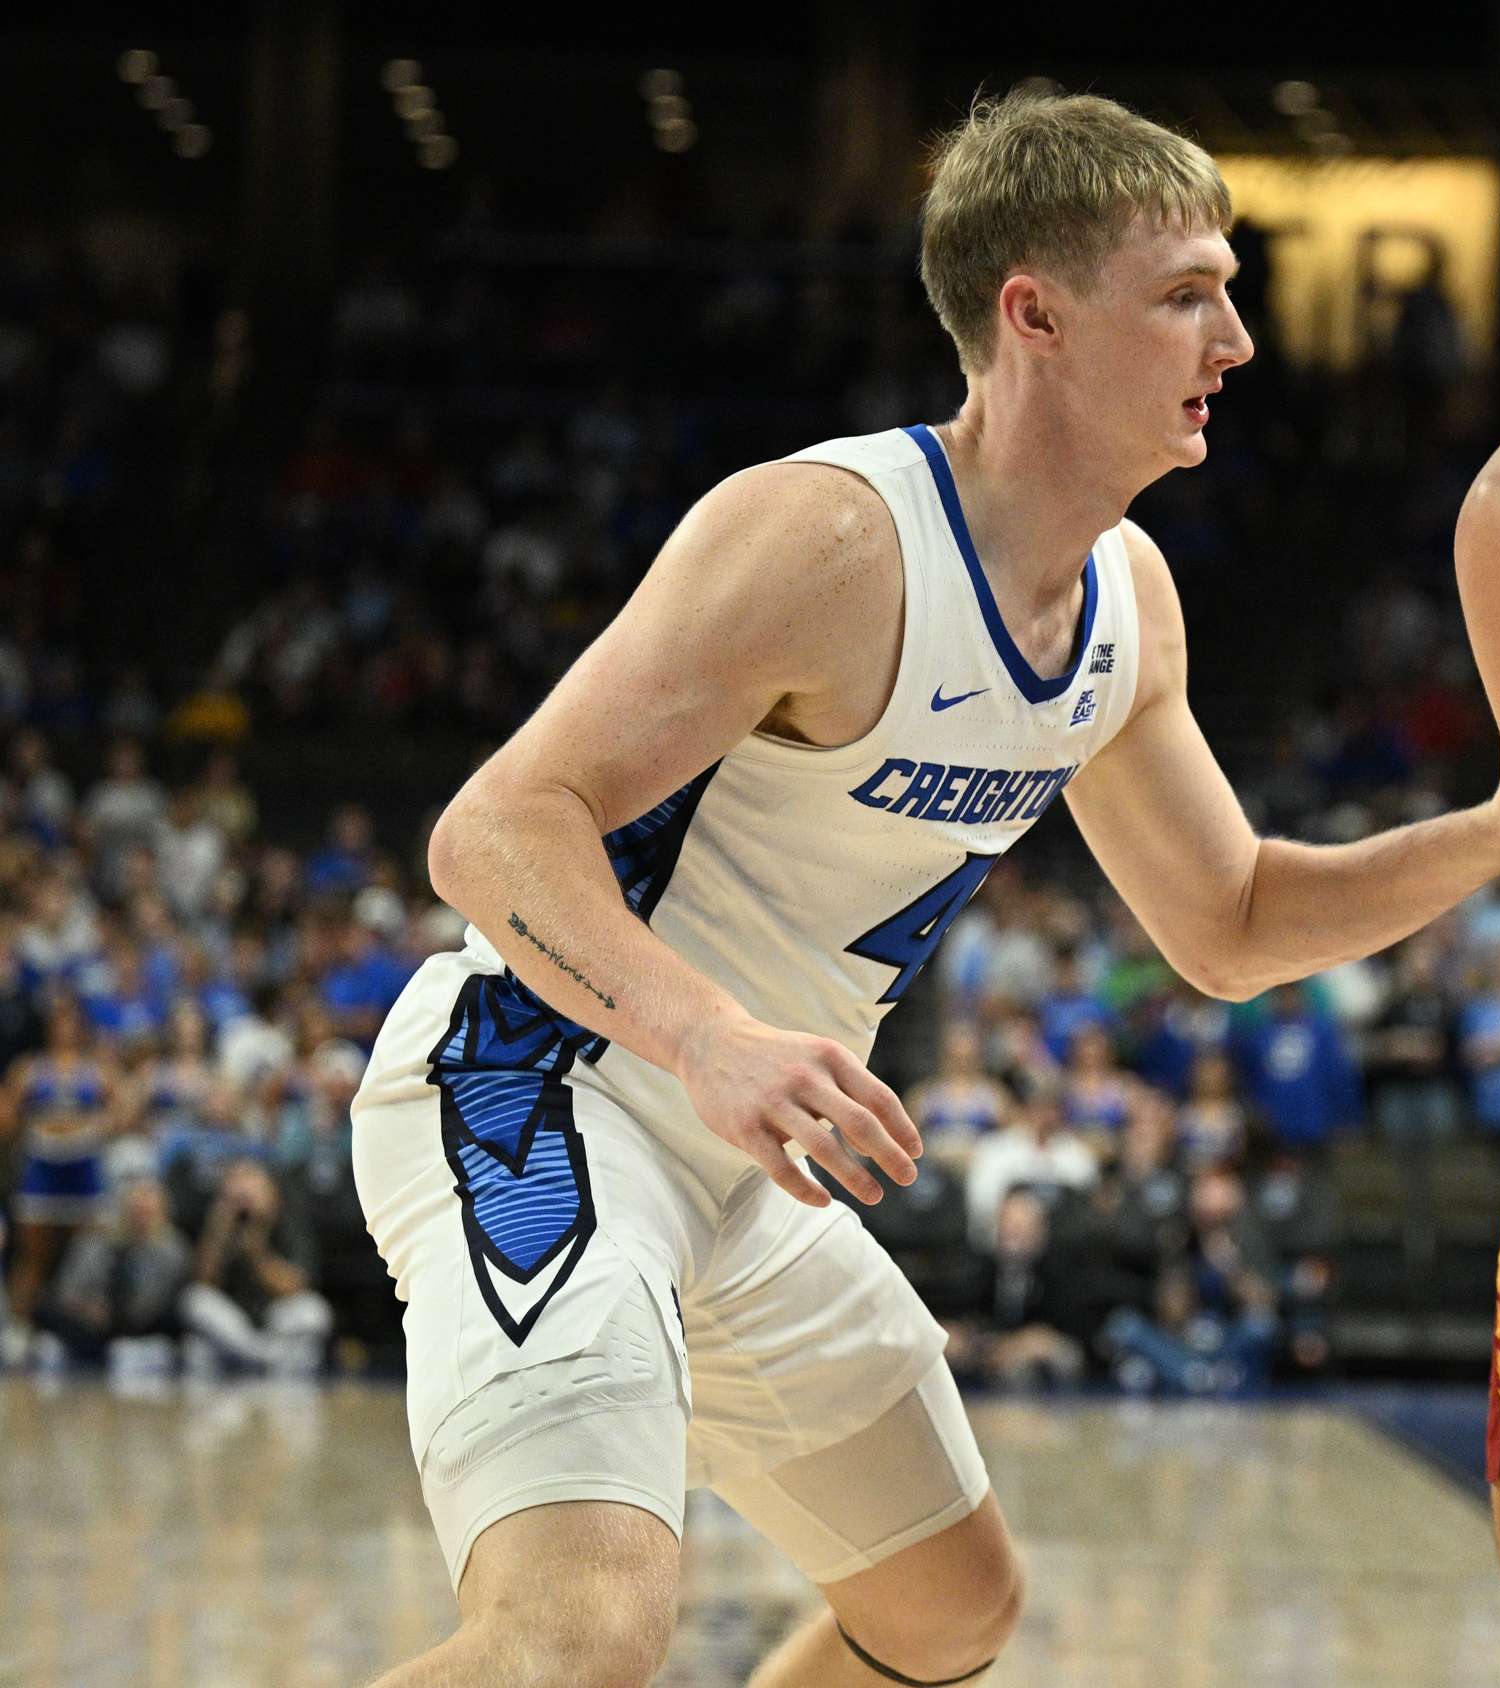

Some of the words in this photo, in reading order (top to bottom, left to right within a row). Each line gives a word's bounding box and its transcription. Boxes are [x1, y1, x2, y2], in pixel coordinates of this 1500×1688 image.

[1097, 643, 1115, 659] THE
[1071, 703, 1096, 720] EAST
[843, 851, 1001, 1004] 4
